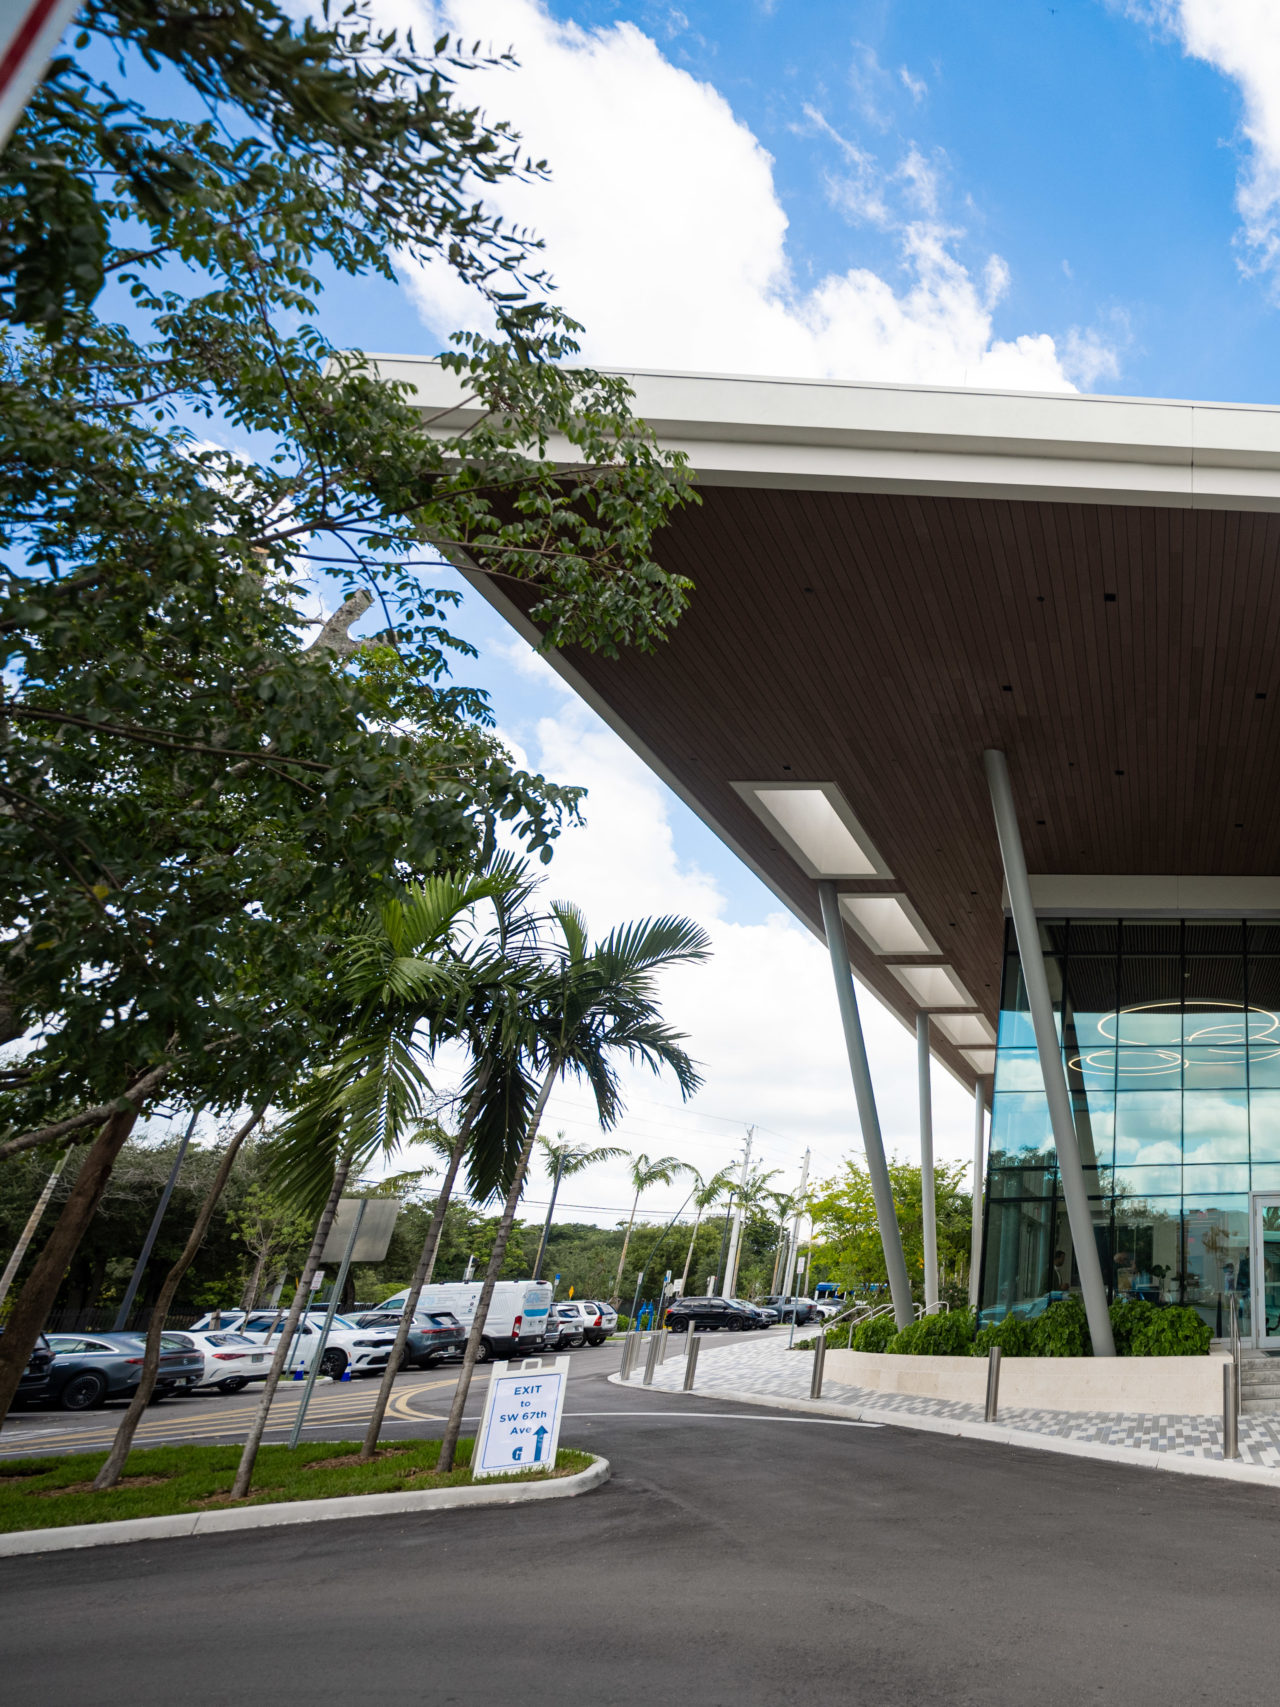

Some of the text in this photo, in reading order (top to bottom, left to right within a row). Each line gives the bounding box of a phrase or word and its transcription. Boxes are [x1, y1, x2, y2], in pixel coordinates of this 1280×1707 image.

[514, 1385, 542, 1395] EXIT
[500, 1411, 546, 1422] SW 67th
[510, 1426, 532, 1434] Ave
